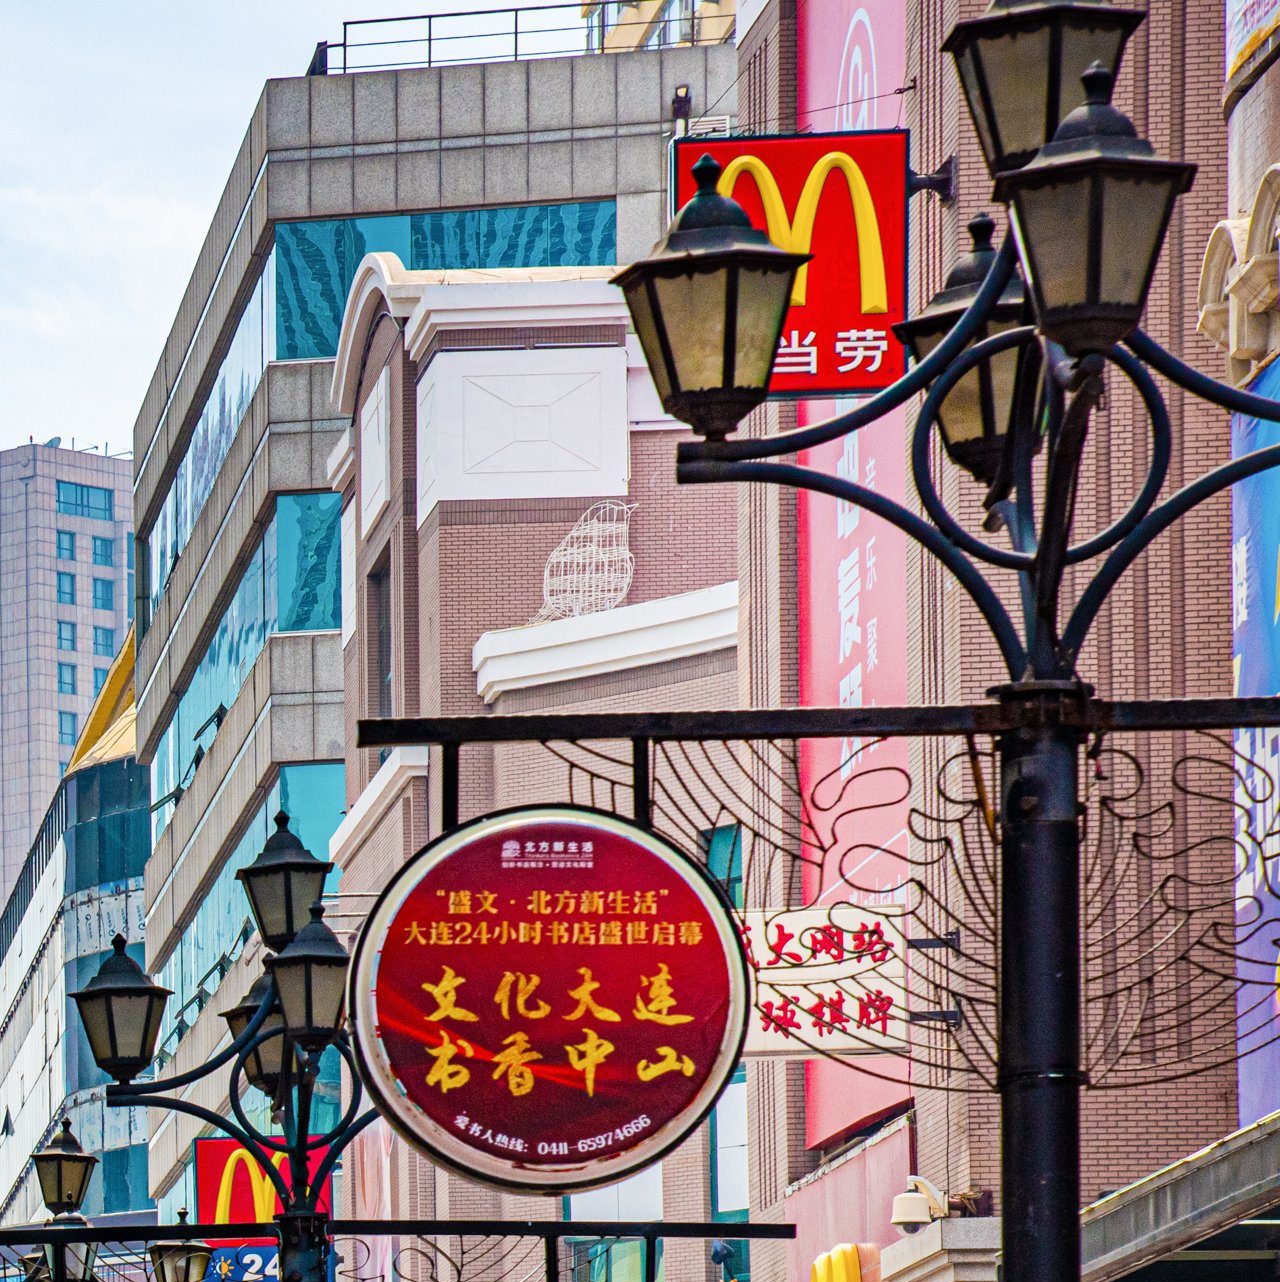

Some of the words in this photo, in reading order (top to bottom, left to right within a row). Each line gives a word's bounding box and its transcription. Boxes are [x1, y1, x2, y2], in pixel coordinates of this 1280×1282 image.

[773, 329, 889, 374] 当劳
[404, 921, 703, 946] 大连24小时书店盛世启幕
[421, 963, 695, 1025] 文化大连
[425, 1029, 696, 1097] 书香中山
